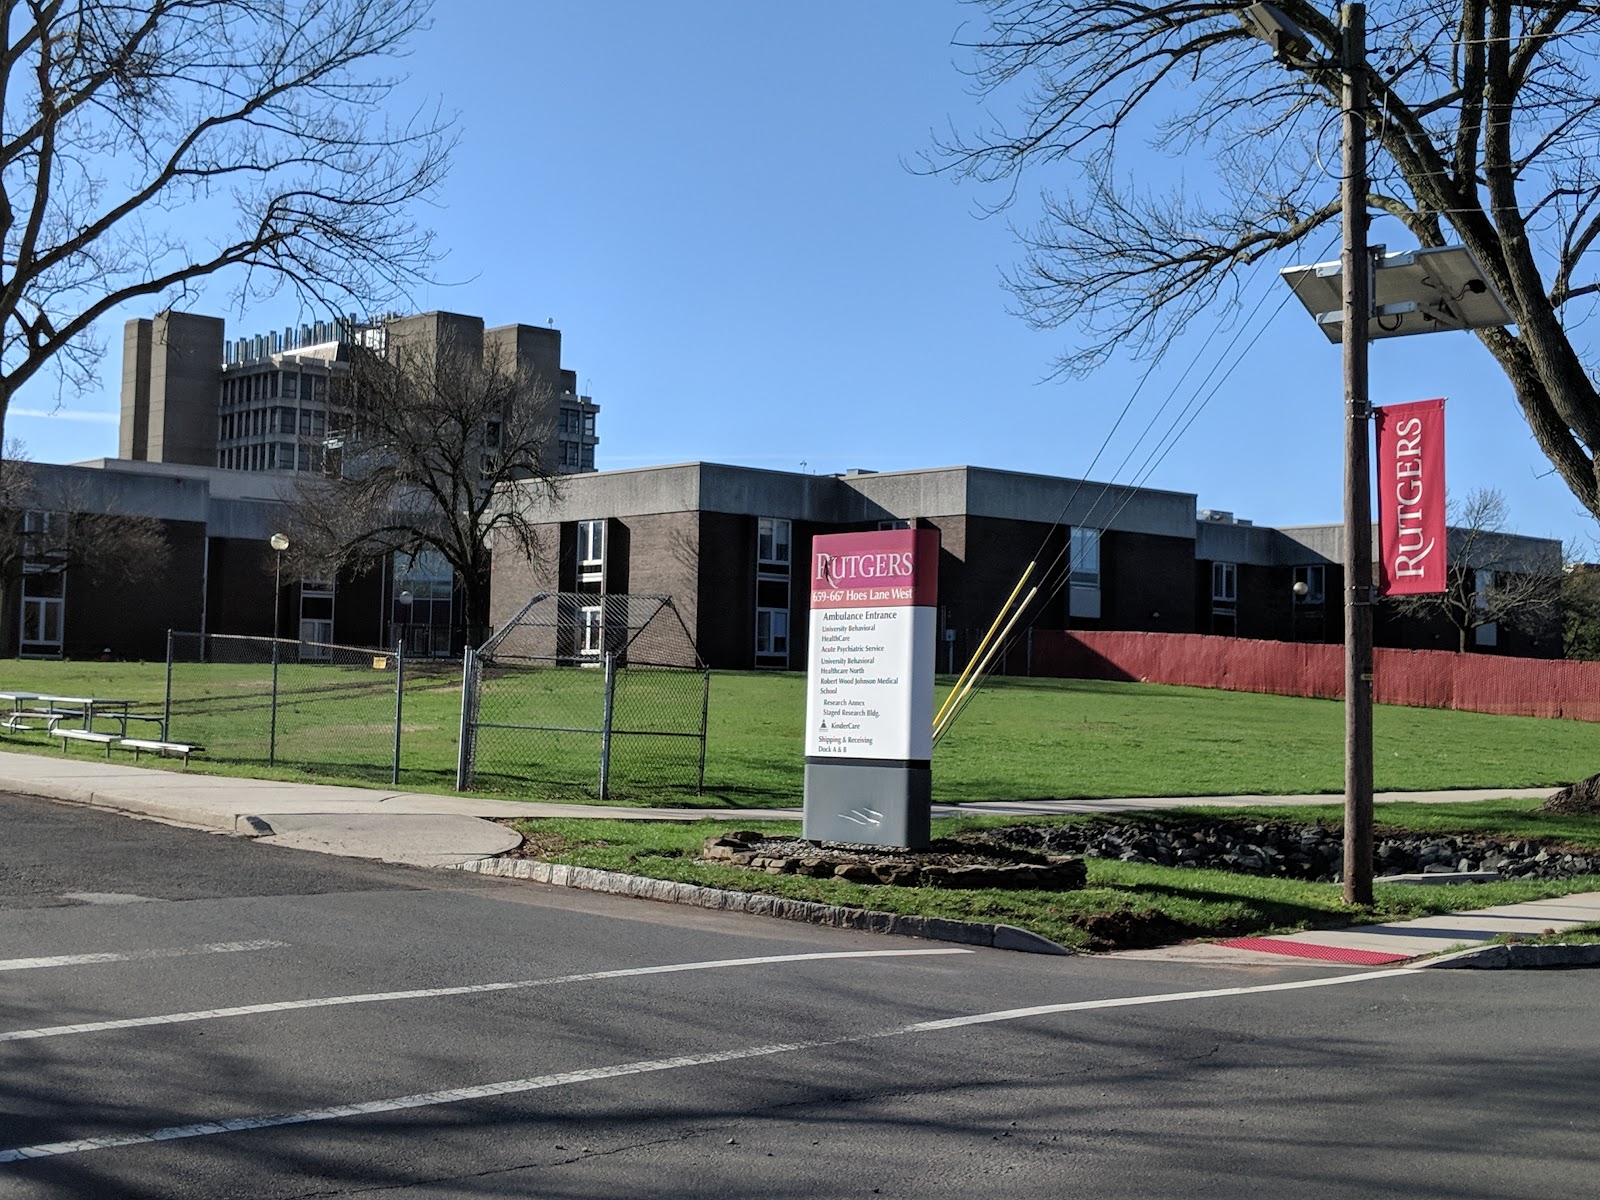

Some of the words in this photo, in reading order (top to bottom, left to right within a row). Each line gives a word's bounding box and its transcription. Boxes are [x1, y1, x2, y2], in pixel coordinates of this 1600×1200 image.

[1395, 417, 1435, 579] RUTGERS
[816, 552, 913, 589] RUTGERS
[812, 591, 844, 602] 659-667
[846, 590, 867, 600] Hoes
[870, 589, 889, 600] Lane
[891, 588, 912, 599] West
[823, 611, 863, 621] Ambulance
[865, 611, 897, 620] Entrance
[822, 625, 847, 633] University
[848, 624, 876, 632] Behavioral
[837, 645, 864, 654] Psychiatric
[821, 657, 846, 665] University
[854, 677, 876, 685] Johnson
[823, 709, 840, 717] Staged
[867, 709, 880, 718] Bldg.
[818, 736, 841, 745] Shipping
[848, 736, 873, 745] Receiving
